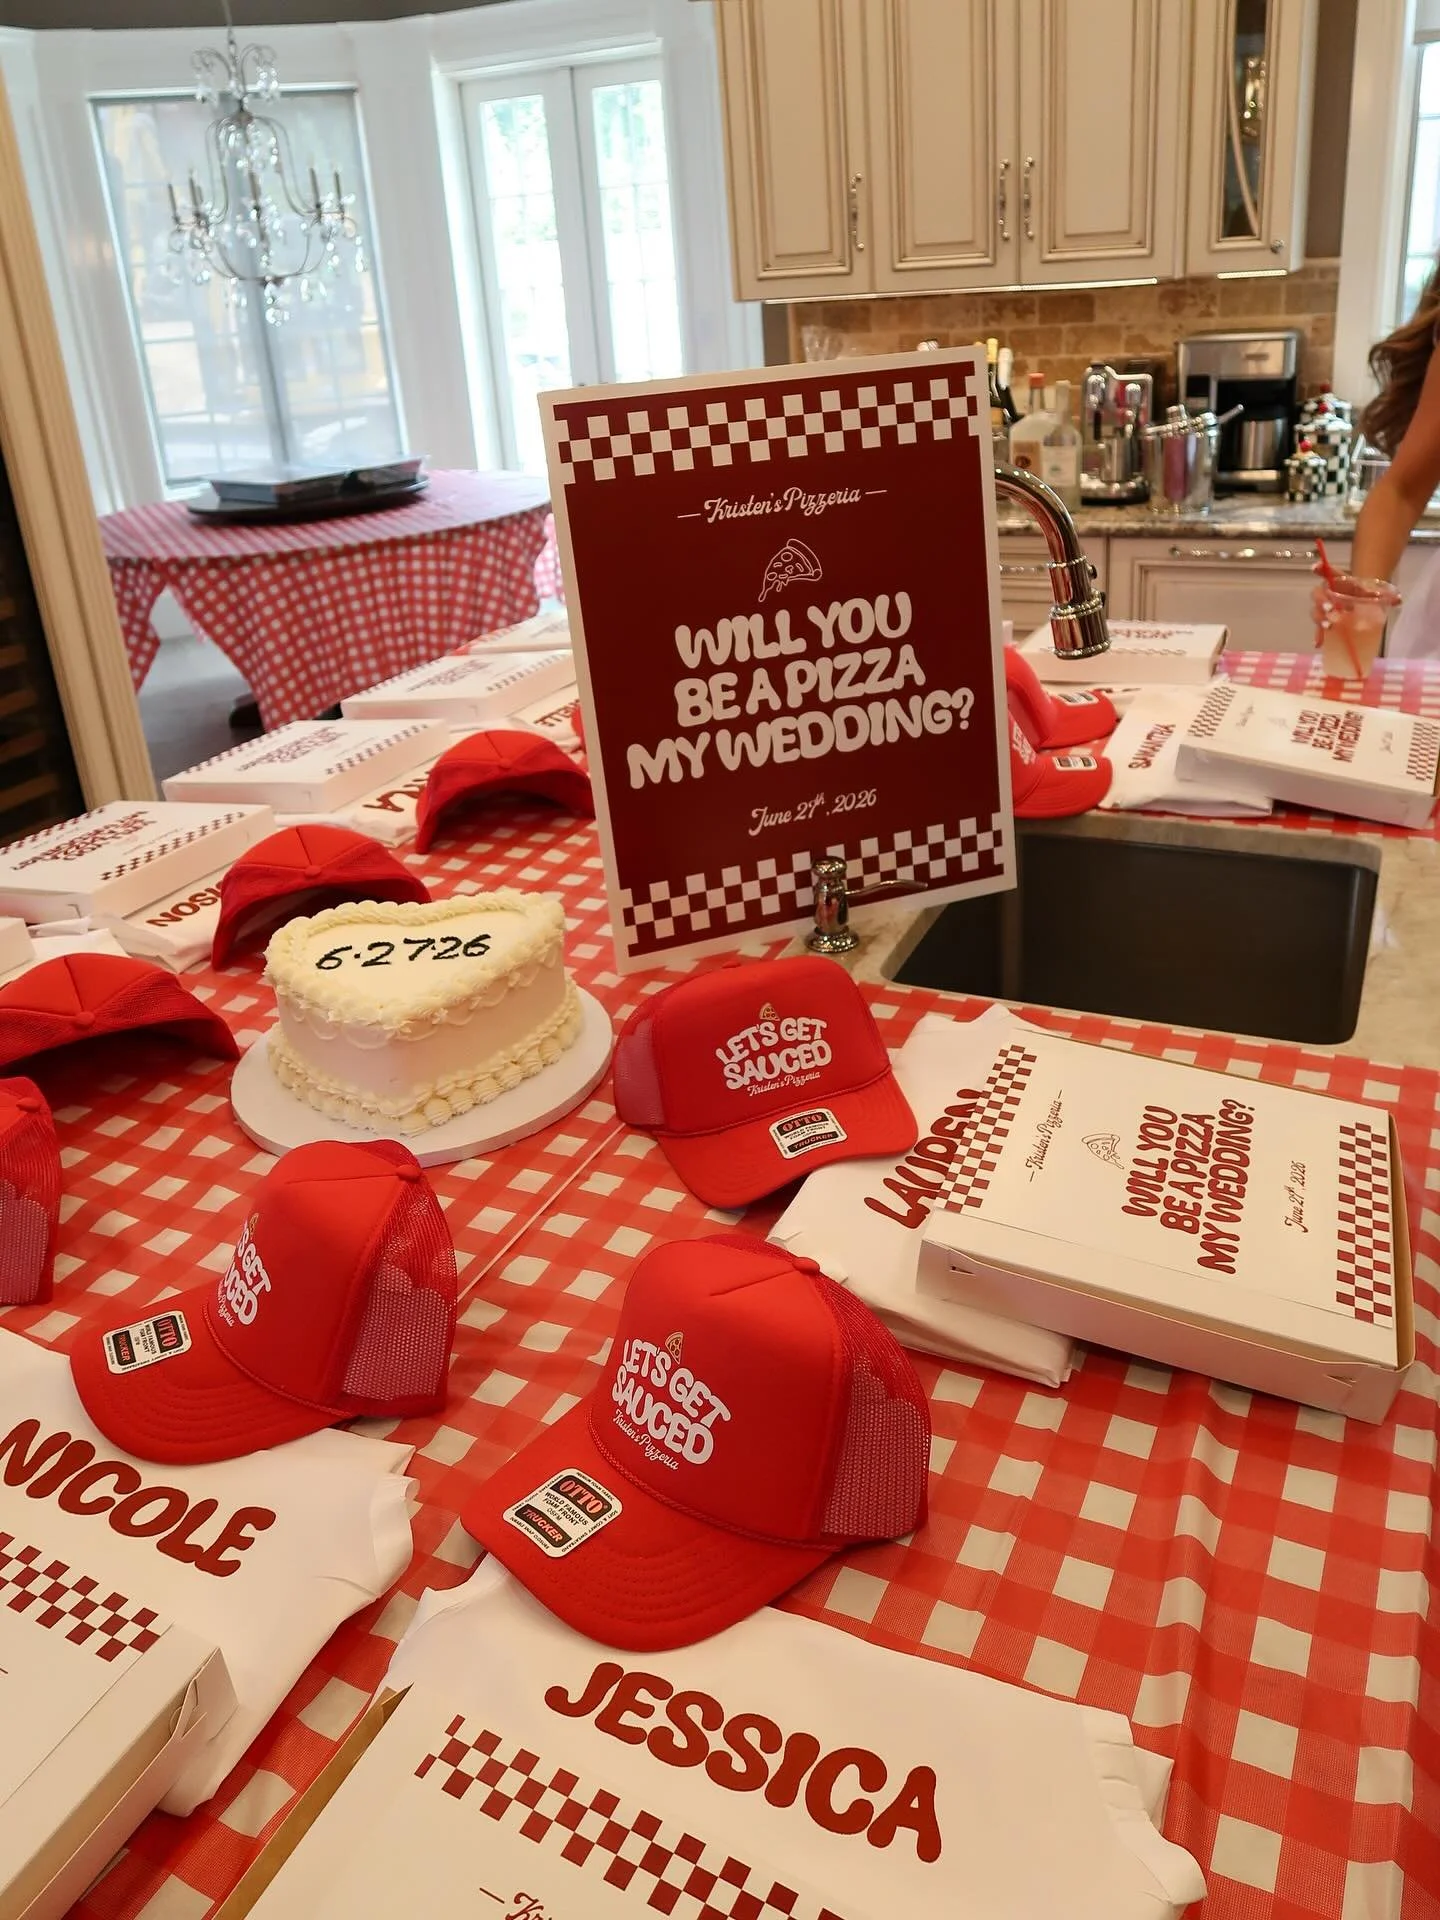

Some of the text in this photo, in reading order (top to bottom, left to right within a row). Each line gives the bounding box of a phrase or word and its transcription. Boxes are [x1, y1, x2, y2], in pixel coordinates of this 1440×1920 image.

[704, 487, 862, 523] Kristen's Pizzeria
[675, 591, 913, 669] WILL YOU
[674, 643, 926, 727] BE A PIZZA
[626, 731, 711, 790] MY
[715, 687, 975, 771] WEDDING?
[748, 806, 792, 837] June
[831, 788, 877, 814] 2026
[146, 880, 223, 927] ISON
[715, 1016, 827, 1065] LET'S GET
[723, 1039, 832, 1090] SAUCED
[782, 1114, 822, 1132] OTTO
[793, 1133, 834, 1149] TRUCKER
[1025, 1099, 1064, 1170] Kristen's Pizzeria
[1121, 1105, 1178, 1217] WILL YOU
[1159, 1113, 1216, 1235] BE A PIZZA
[1197, 1098, 1256, 1275] MY WEDDING?
[1284, 1206, 1309, 1233] June
[242, 1243, 272, 1295] GET
[157, 1318, 178, 1347] OTTO
[622, 1338, 731, 1429] LET'S GET
[612, 1365, 714, 1465] SAUCED
[638, 1433, 680, 1471] Pizzeria
[0, 1418, 277, 1578] NICOLE
[543, 1497, 580, 1527] FOAM FRONT
[544, 1491, 565, 1508] WORLD
[563, 1503, 589, 1526] FAMOUS
[559, 1480, 604, 1514] OTTO
[522, 1509, 564, 1542] TRUCKER
[544, 1661, 943, 1863] JESSICA
